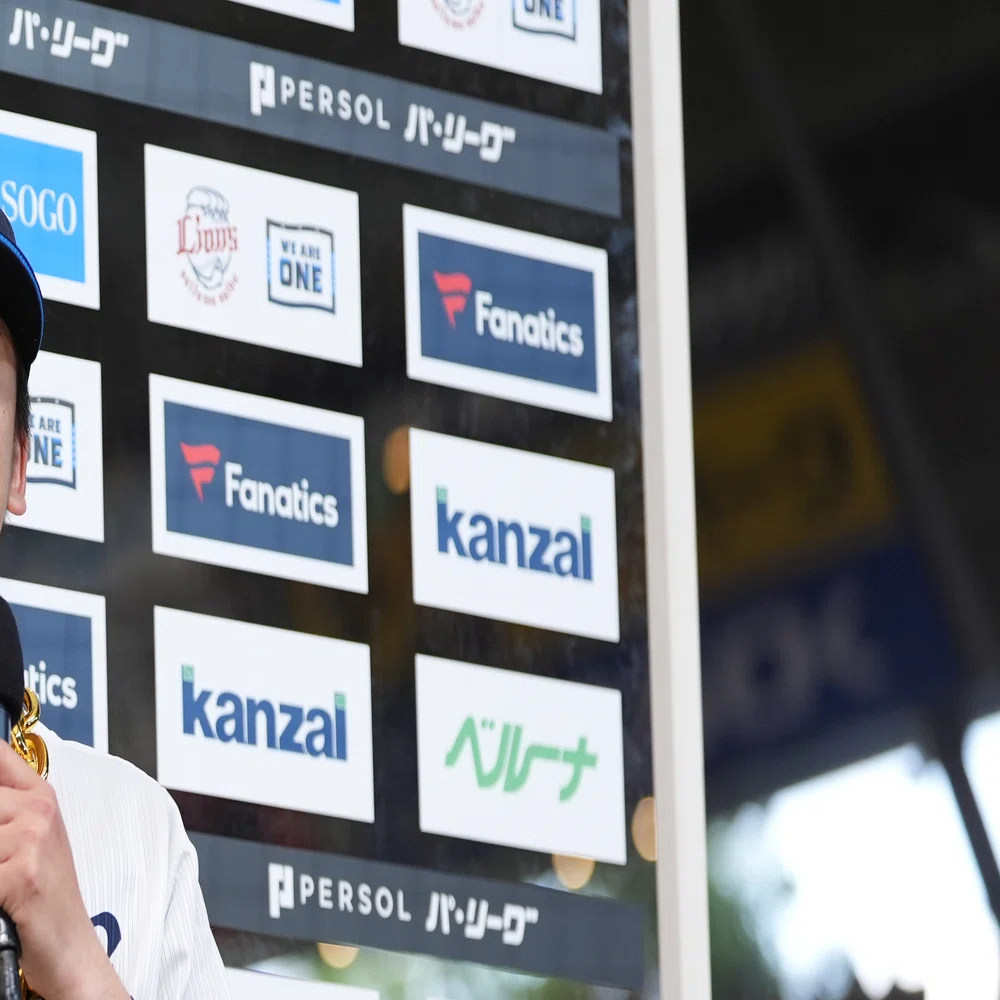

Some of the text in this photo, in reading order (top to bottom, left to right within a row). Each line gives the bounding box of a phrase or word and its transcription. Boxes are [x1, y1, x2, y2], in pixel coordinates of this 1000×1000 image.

[280, 75, 391, 131] PERSOL
[2, 180, 77, 236] SOGO
[176, 214, 239, 255] Lions
[279, 257, 323, 294] ONE
[281, 239, 321, 261] WE ARE
[476, 290, 584, 358] Fanatics
[28, 433, 63, 468] NE
[39, 415, 61, 433] ARE
[224, 462, 339, 528] Fanatics
[436, 485, 593, 581] kanzai
[24, 660, 78, 710] tics
[181, 664, 348, 762] kanzai
[444, 715, 598, 803] ベルーナ
[299, 873, 411, 922] PERSOL
